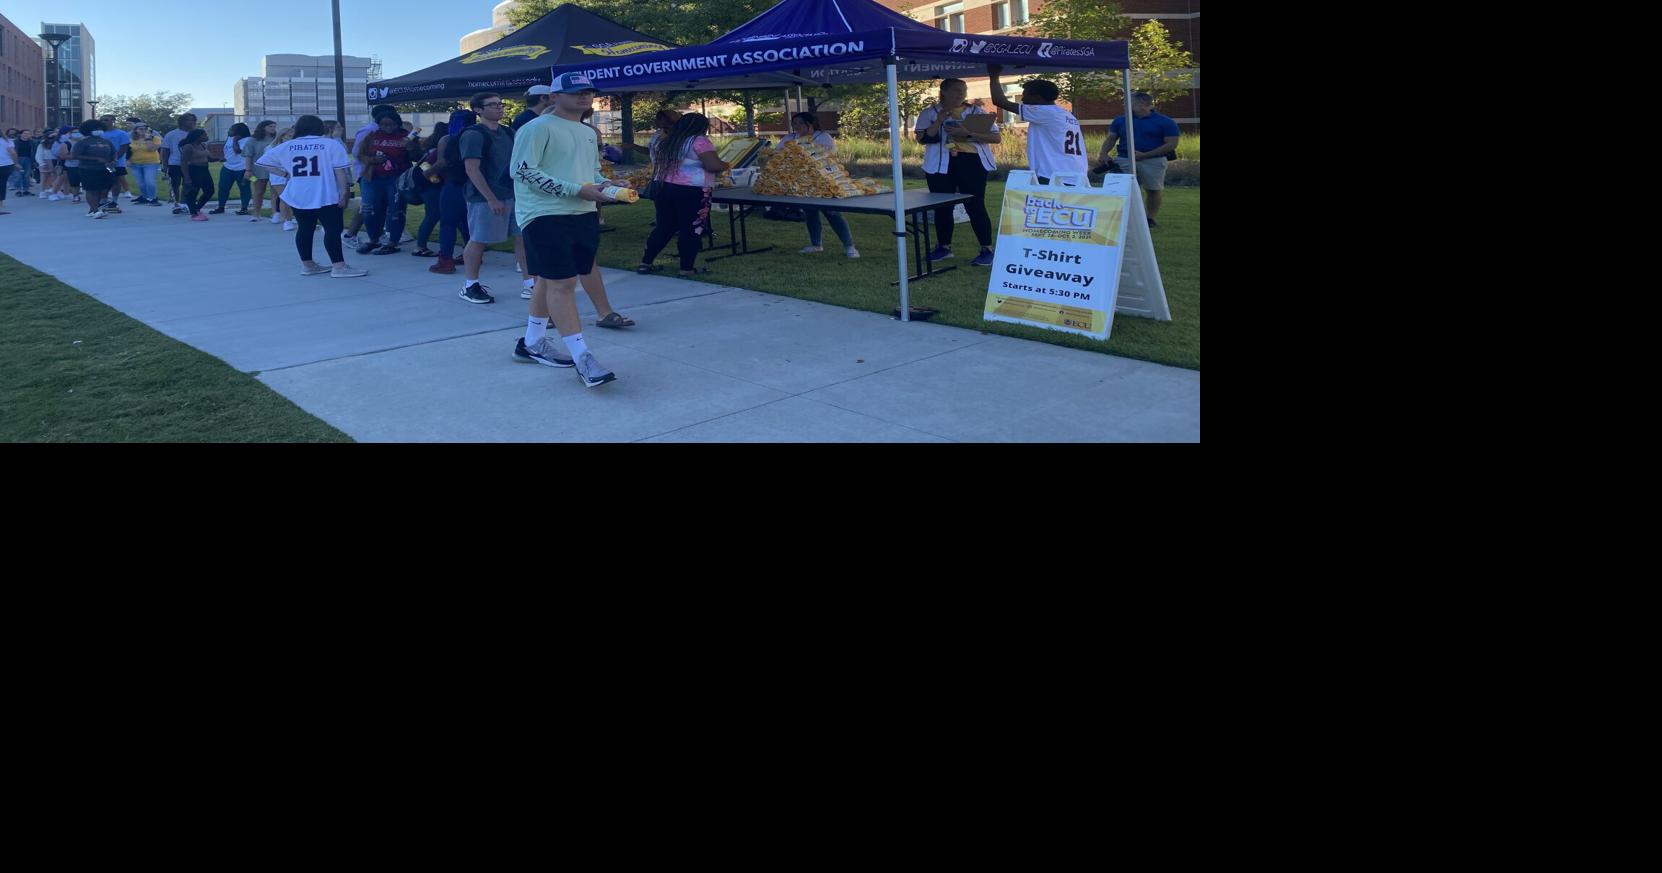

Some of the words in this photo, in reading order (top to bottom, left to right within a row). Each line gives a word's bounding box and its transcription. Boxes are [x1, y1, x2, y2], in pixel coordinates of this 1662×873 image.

[622, 54, 727, 77] GOVERNMENT
[731, 40, 864, 66] ASSOCIATION
[289, 143, 326, 152] PIRATES
[1064, 130, 1082, 156] 21
[292, 155, 320, 177] 21
[1034, 207, 1088, 228] ECU
[1023, 247, 1082, 265] T-Shirt
[1005, 263, 1095, 287] Giveaway
[1002, 281, 1033, 292] Starts
[1049, 288, 1071, 298] 5:30
[1073, 291, 1091, 301] PM
